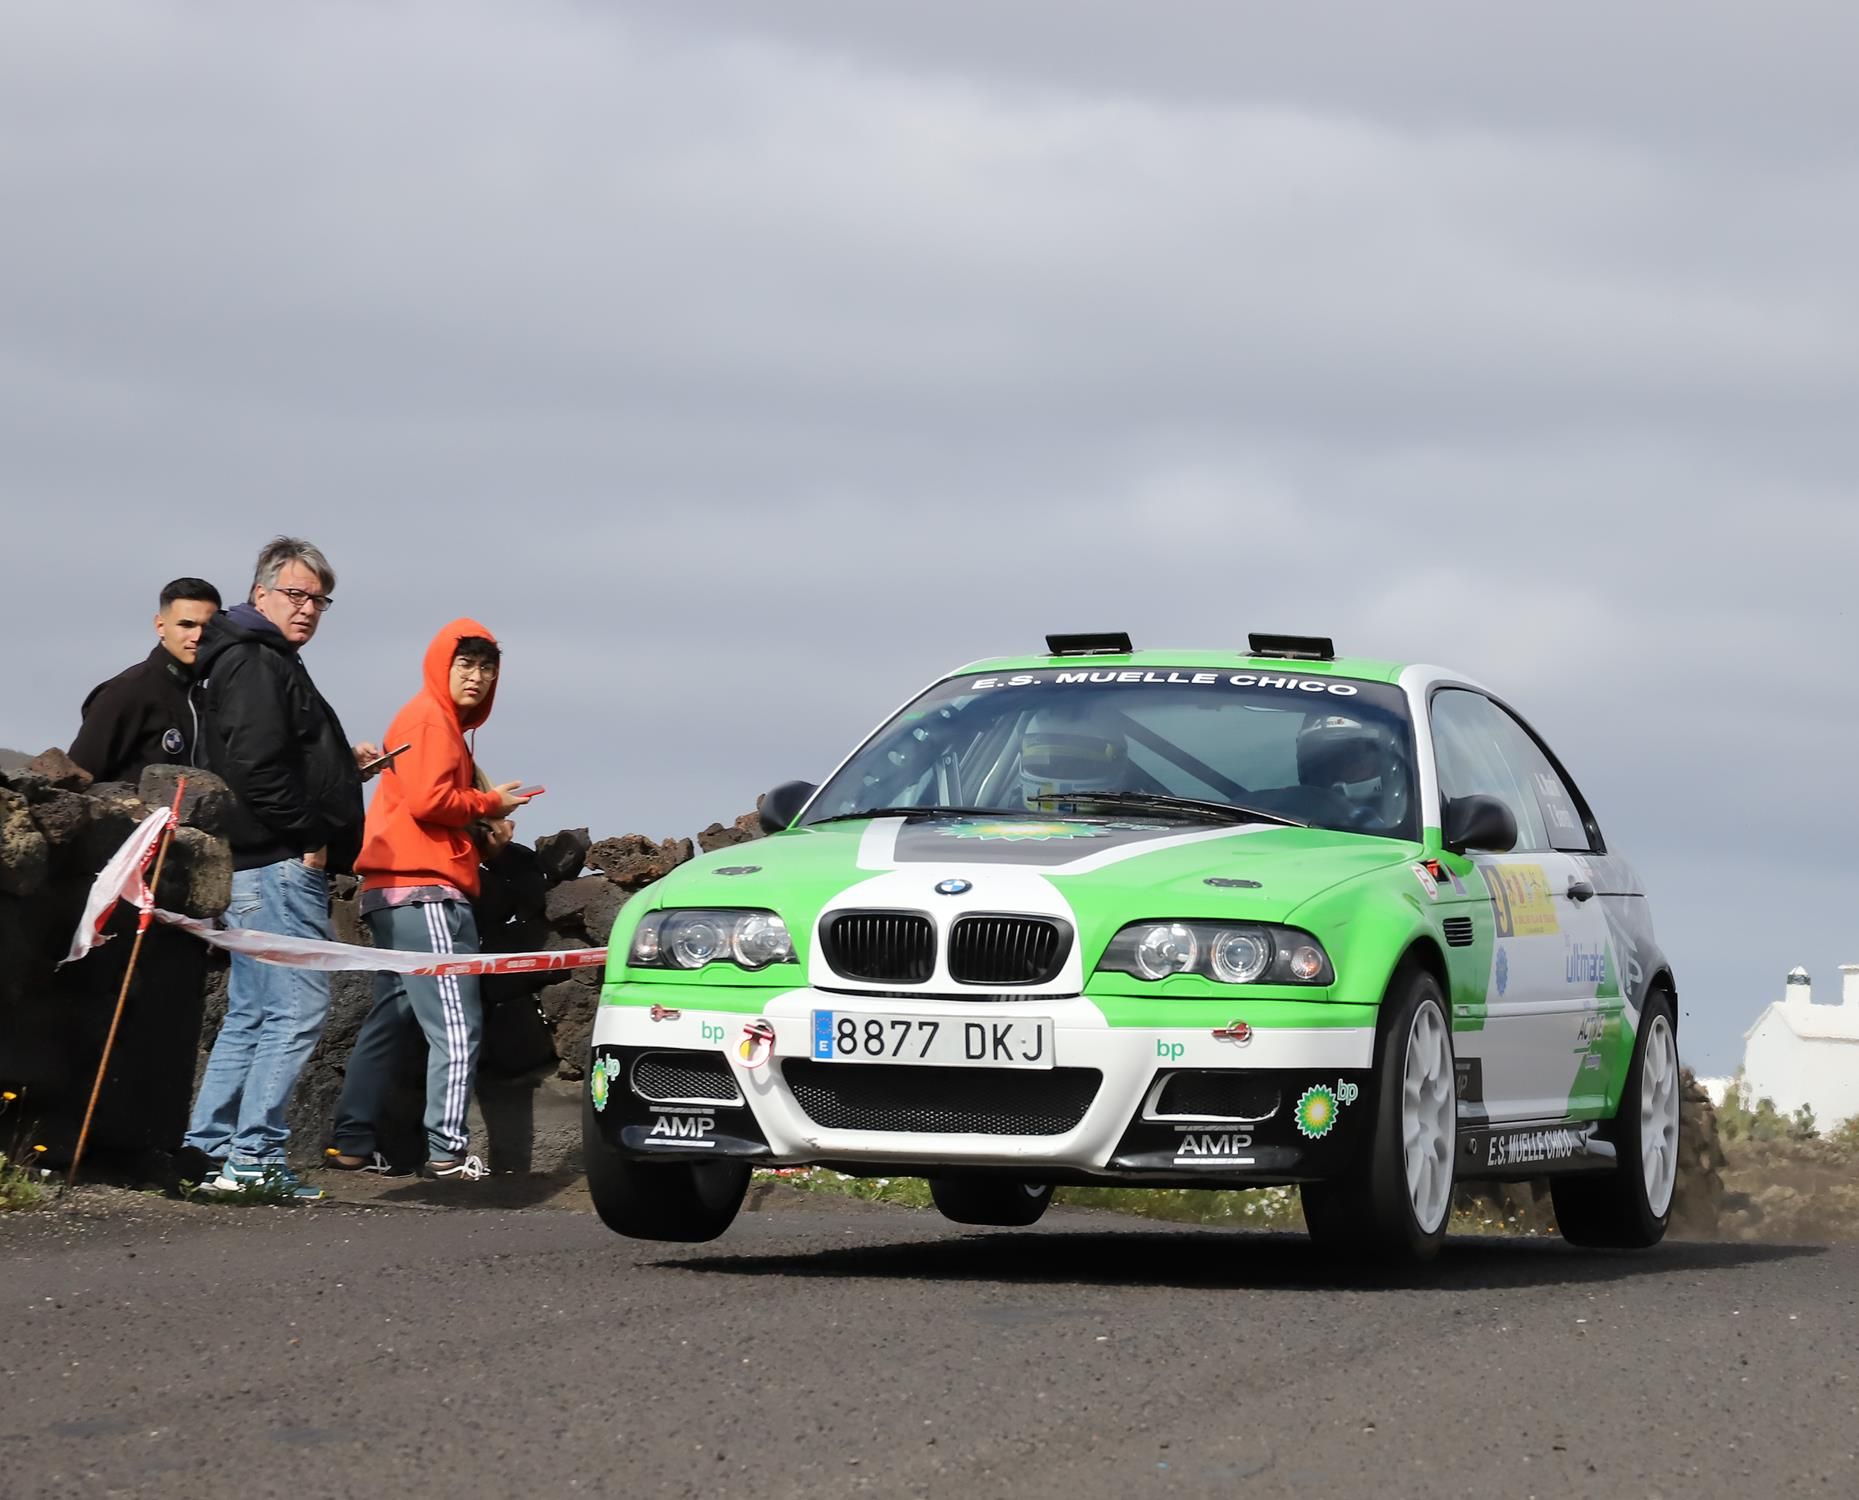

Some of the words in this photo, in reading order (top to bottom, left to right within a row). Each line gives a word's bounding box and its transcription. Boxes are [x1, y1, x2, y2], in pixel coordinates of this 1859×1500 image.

[972, 675, 1042, 690] E.S.
[1056, 671, 1218, 684] MUELLE
[1229, 674, 1358, 696] CHICO
[701, 1021, 725, 1044] bp
[837, 1017, 940, 1058] 8877
[965, 1022, 1043, 1062] DKJ
[819, 1040, 828, 1051] E
[1156, 1039, 1185, 1061] bp
[605, 1052, 621, 1081] bp
[1337, 1079, 1359, 1106] bp
[650, 1115, 715, 1138] AMP
[1176, 1134, 1253, 1155] AMP
[1487, 1135, 1506, 1166] E.S.
[1508, 1131, 1545, 1164] MUELLE
[1545, 1128, 1573, 1160] CHICO
